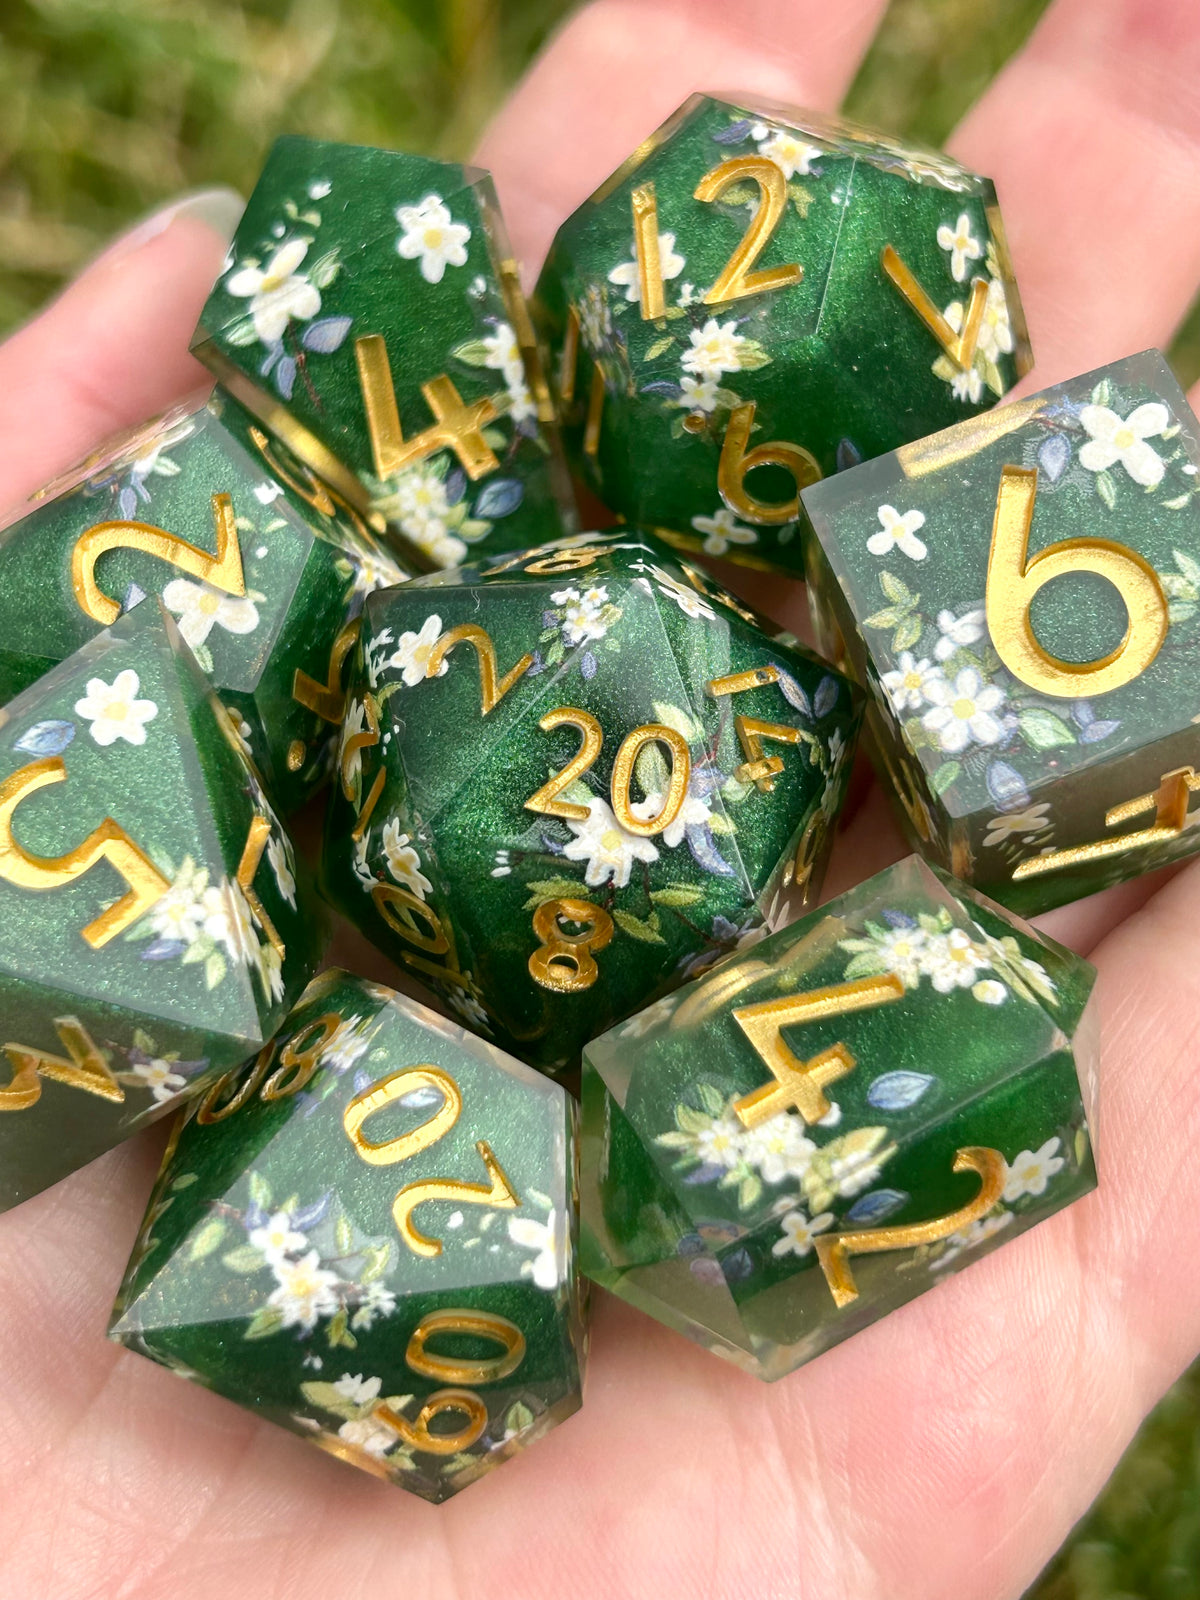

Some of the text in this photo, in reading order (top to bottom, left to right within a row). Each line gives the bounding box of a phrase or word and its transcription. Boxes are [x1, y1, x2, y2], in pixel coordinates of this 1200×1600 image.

[631, 155, 803, 321] 12
[355, 334, 501, 482] 4
[71, 492, 247, 626] 2
[985, 465, 1169, 698] 6
[426, 622, 534, 716] 2
[523, 706, 692, 837] 20
[0, 756, 172, 949] 5
[527, 899, 615, 993] 8
[733, 972, 906, 1131] 4
[343, 1063, 523, 1258] 20
